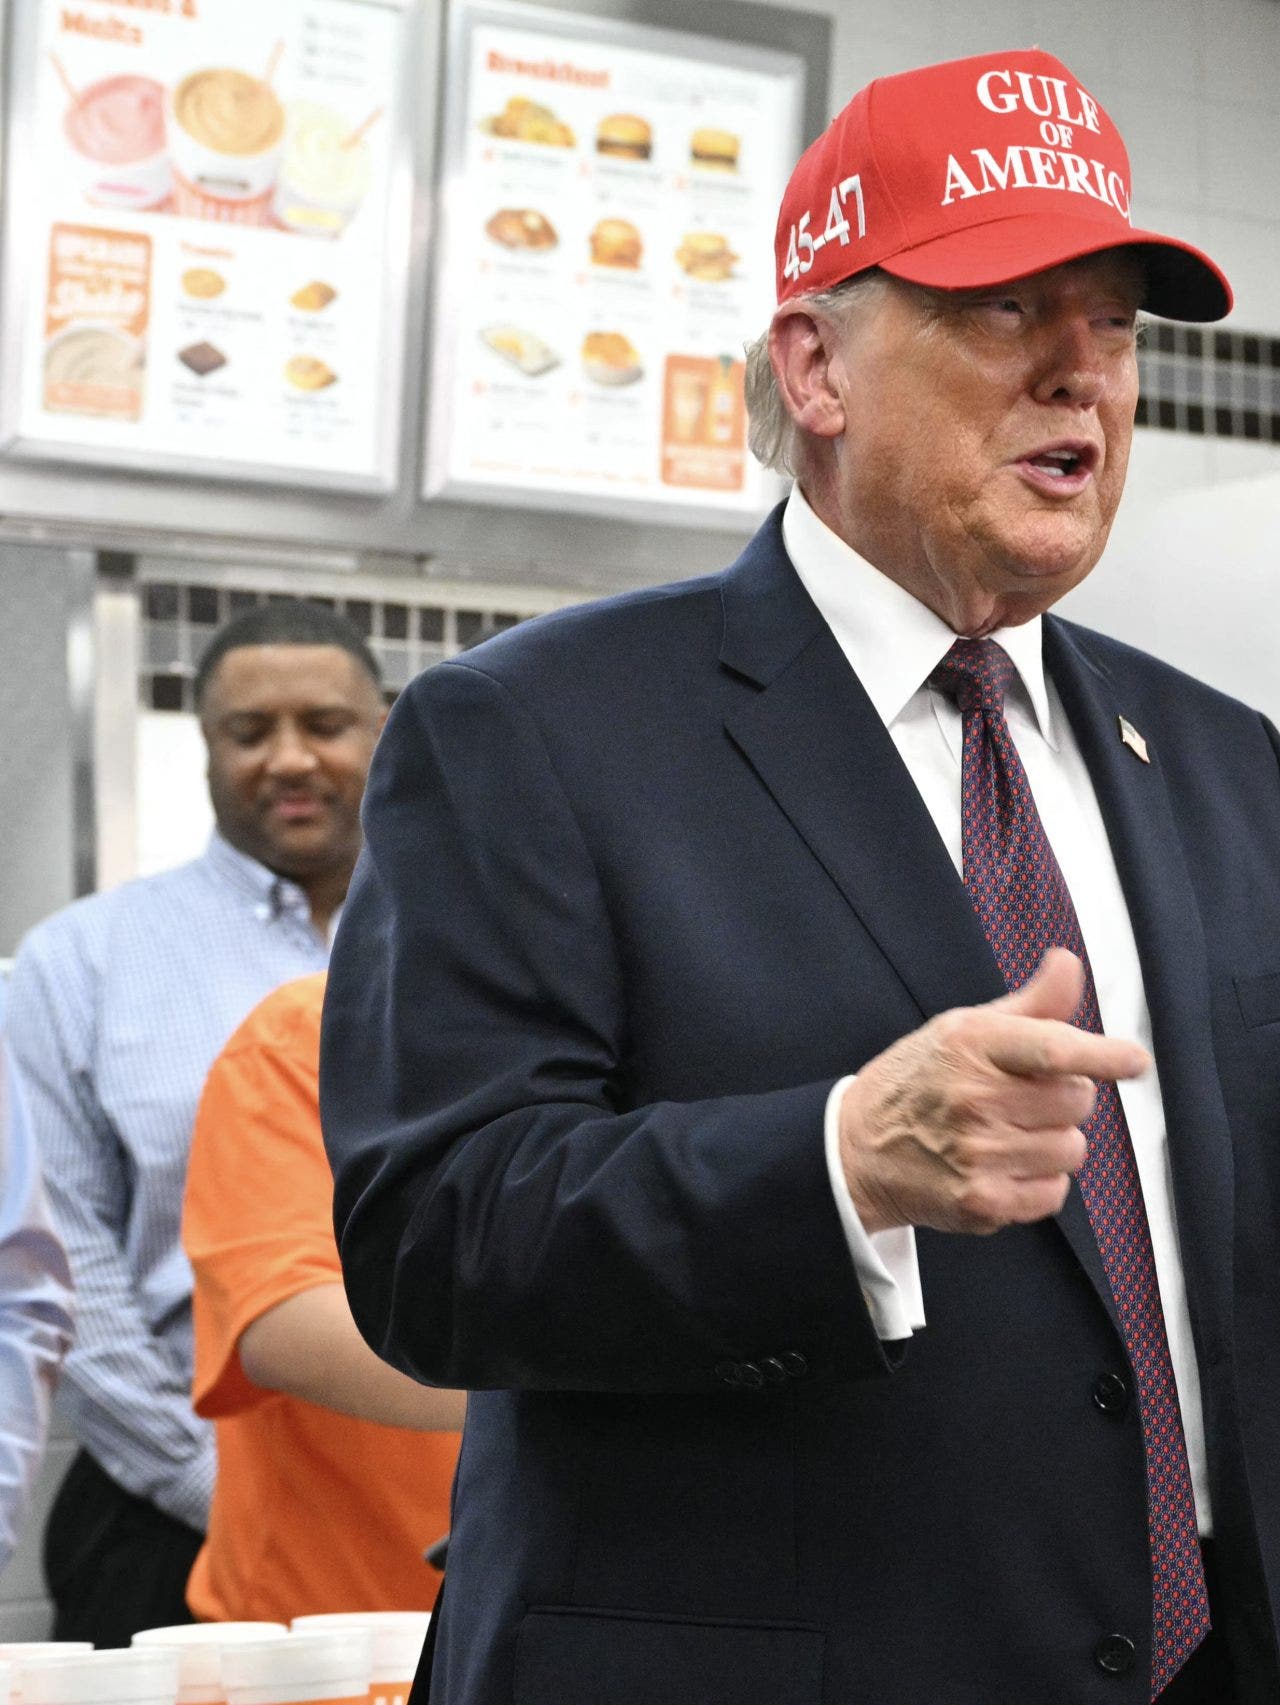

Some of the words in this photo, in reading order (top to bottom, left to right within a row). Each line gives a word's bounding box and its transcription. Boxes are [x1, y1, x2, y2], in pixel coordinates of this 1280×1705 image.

[975, 70, 1101, 135] GULF
[1039, 120, 1074, 149] OF
[941, 146, 1133, 228] AMERIC
[783, 173, 866, 282] 45-47
